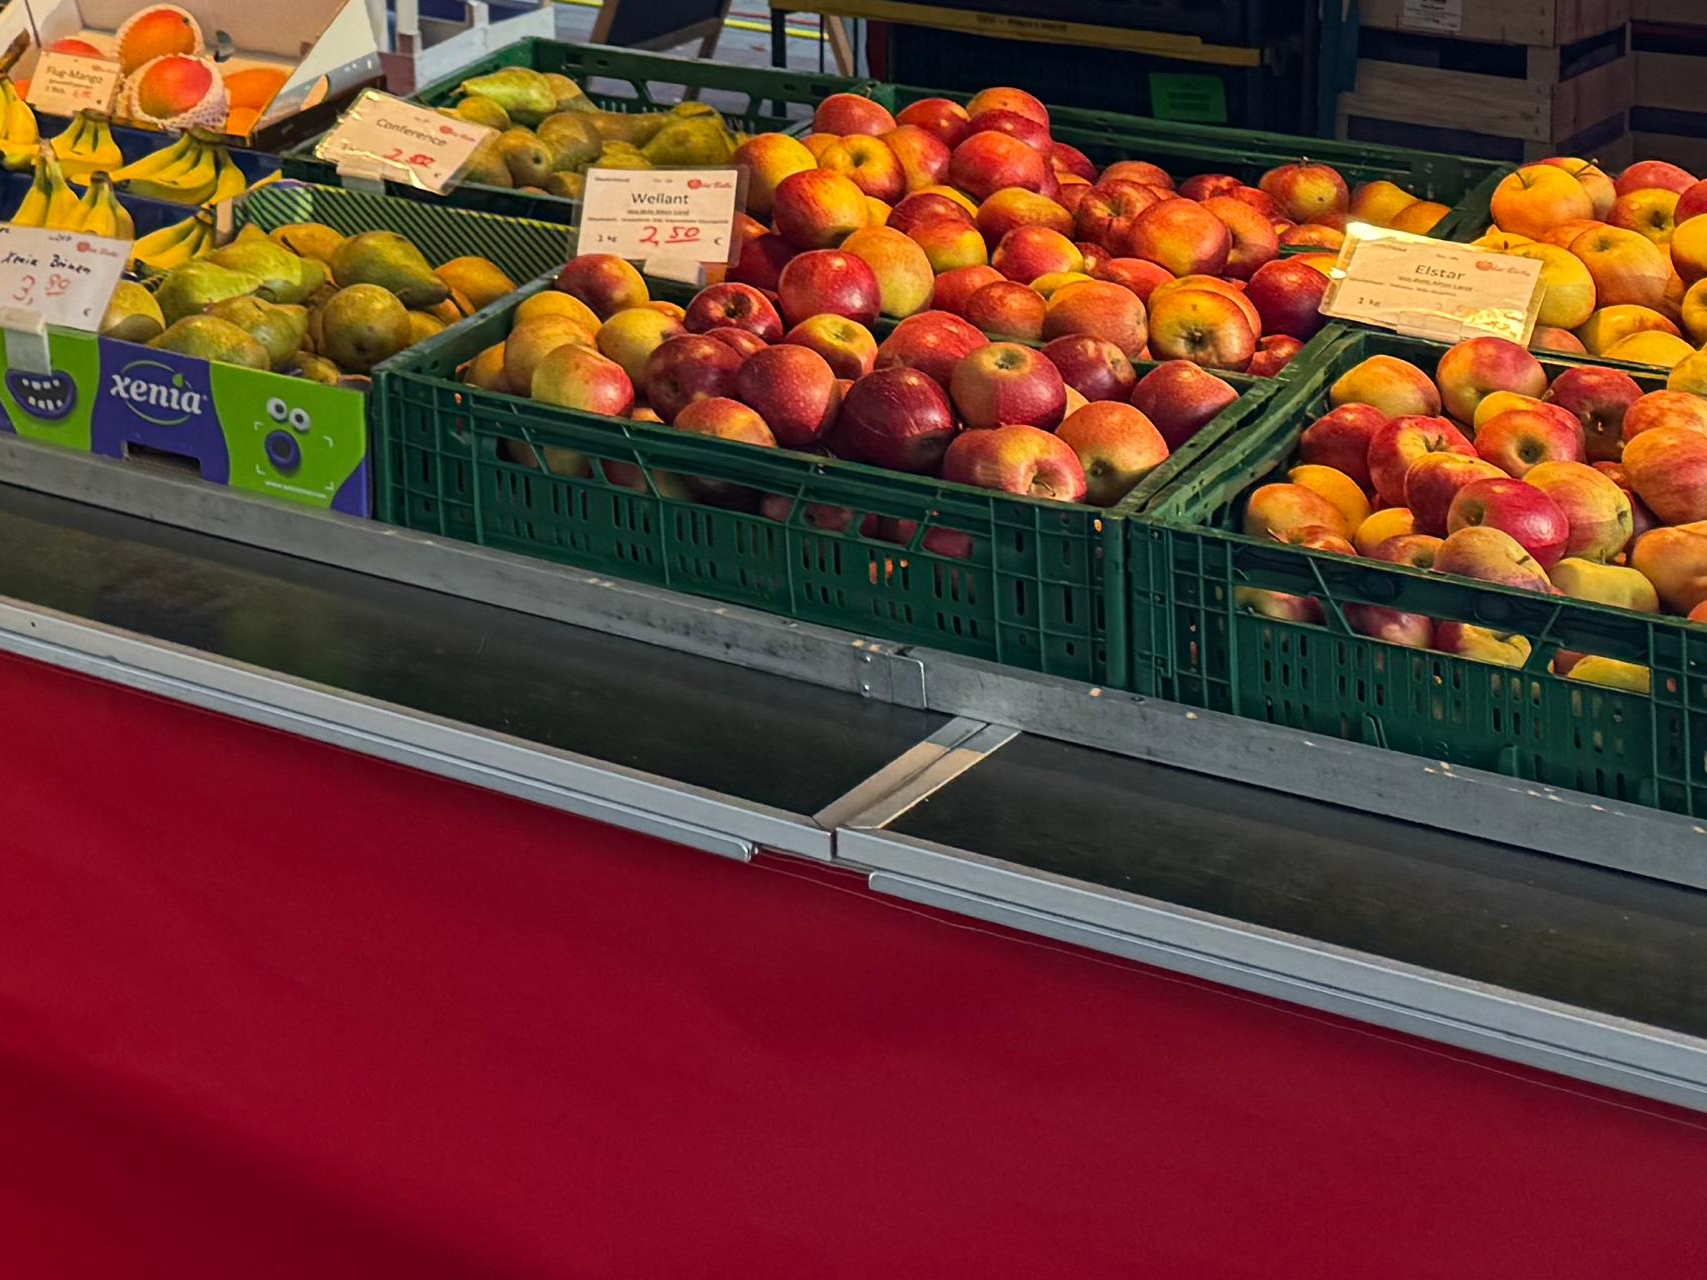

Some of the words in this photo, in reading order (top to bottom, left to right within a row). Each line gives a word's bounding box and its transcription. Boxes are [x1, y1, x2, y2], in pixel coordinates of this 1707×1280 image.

[375, 117, 448, 147] Conference
[632, 192, 690, 206] Wellant
[1414, 264, 1468, 281] Elstar
[109, 374, 203, 416] xenia
